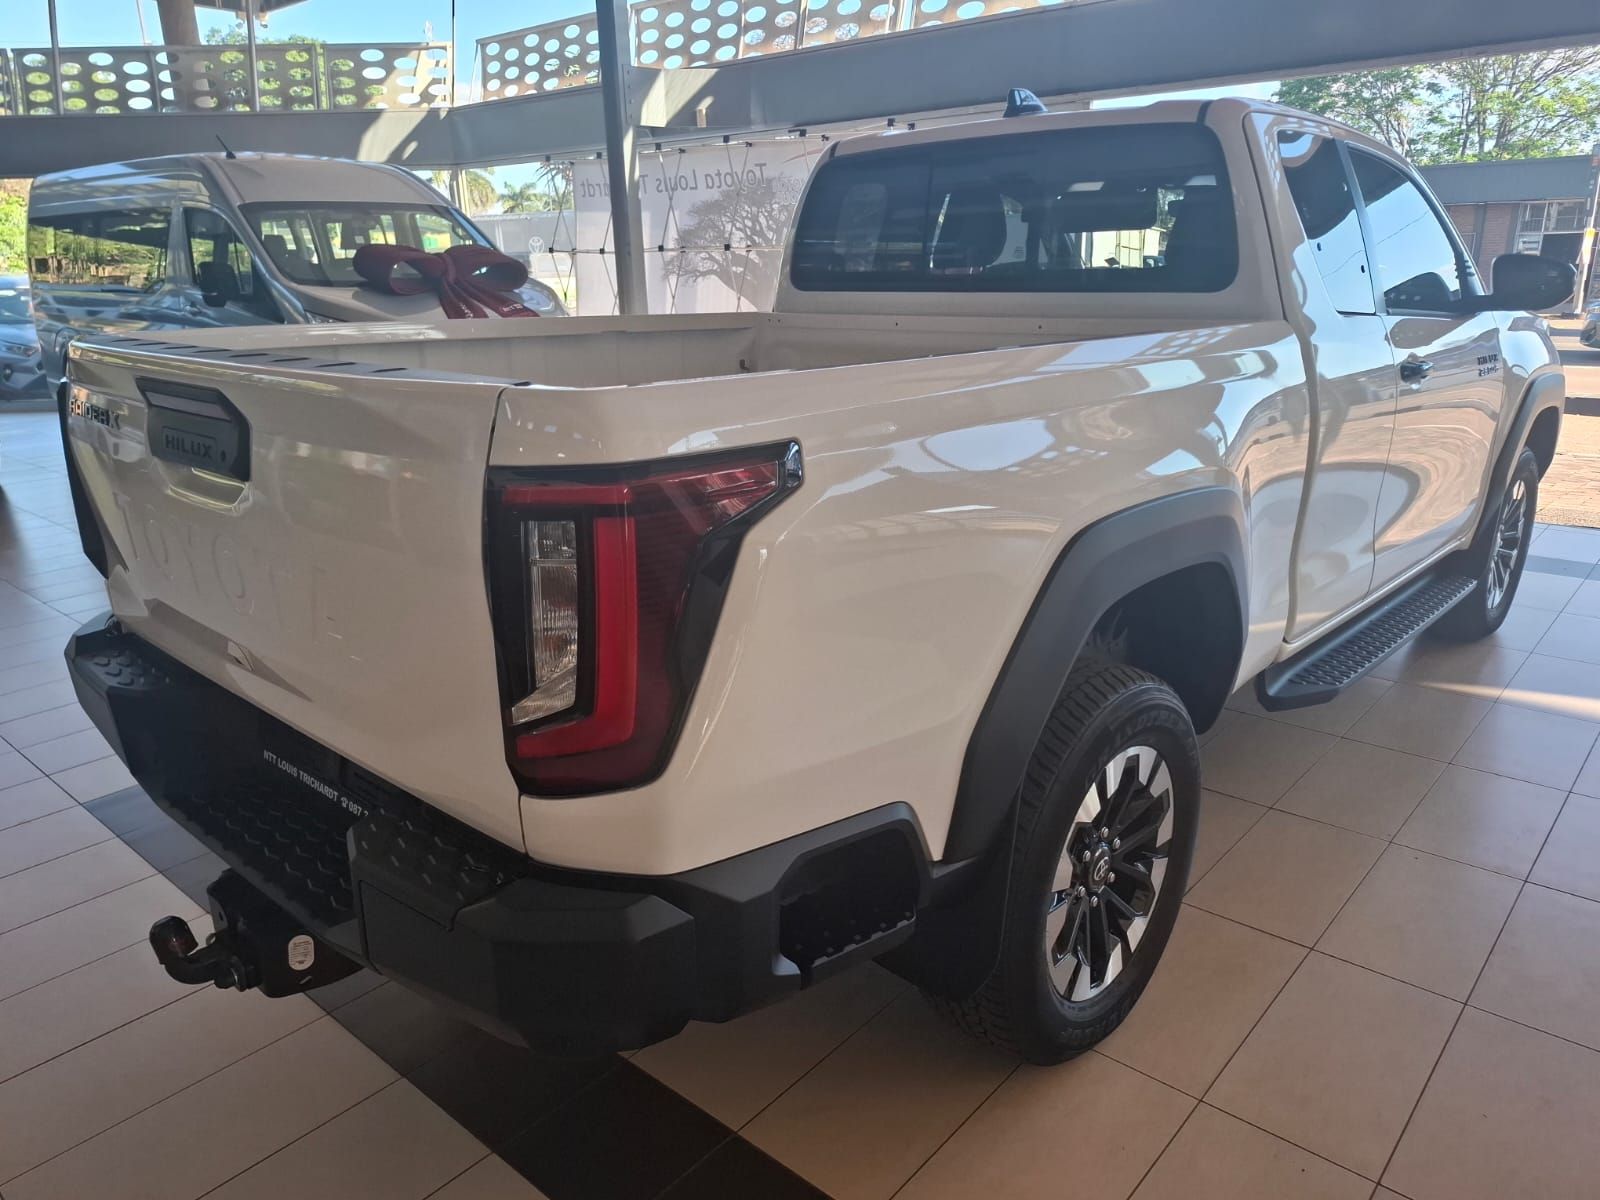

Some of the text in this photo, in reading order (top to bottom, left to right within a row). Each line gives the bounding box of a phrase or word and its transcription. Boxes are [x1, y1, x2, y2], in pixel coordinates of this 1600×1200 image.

[164, 434, 213, 462] HILUX
[263, 749, 277, 765] NTT
[277, 758, 298, 777] LOUIS
[299, 770, 339, 802] TRICHARDT
